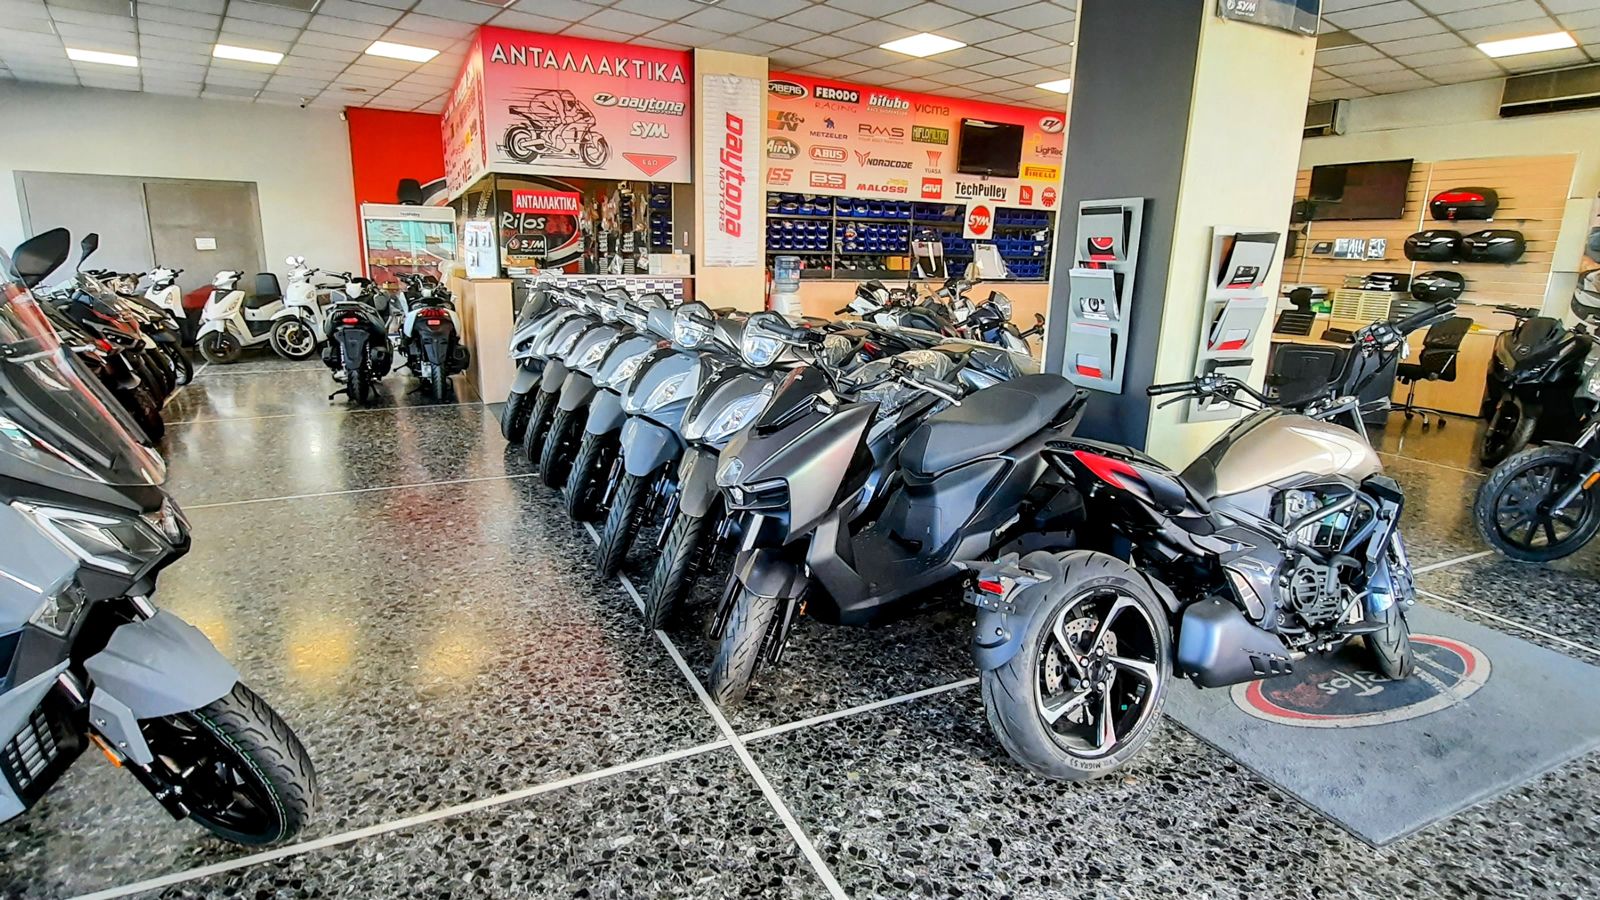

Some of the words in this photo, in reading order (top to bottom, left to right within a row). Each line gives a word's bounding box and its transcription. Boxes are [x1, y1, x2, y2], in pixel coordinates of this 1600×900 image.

[1236, 1, 1256, 12] SYM
[490, 42, 686, 84] ΑΝΤΑΛΛΑΚΤΙΚΑ
[815, 87, 858, 102] FERODO
[869, 94, 910, 110] bitubo
[618, 96, 685, 113] Daytona
[815, 102, 857, 113] RACING
[630, 121, 669, 139] SYM
[810, 131, 848, 140] METZELER
[858, 123, 905, 138] RMS
[813, 149, 843, 160] ABUS
[866, 158, 913, 169] NORDCODE
[924, 167, 942, 175] YUASA
[720, 112, 746, 238] Daytona
[811, 173, 843, 185] BS
[1025, 166, 1057, 179] PIRELLI
[856, 183, 908, 194] MALOSSI
[955, 182, 1007, 199] TechPulley
[516, 194, 578, 211] ΑΝΤΑΛΛΑΚΤΙΚΑ
[501, 211, 546, 234] Rilos
[969, 213, 990, 229] SYM
[521, 240, 544, 249] SYM
